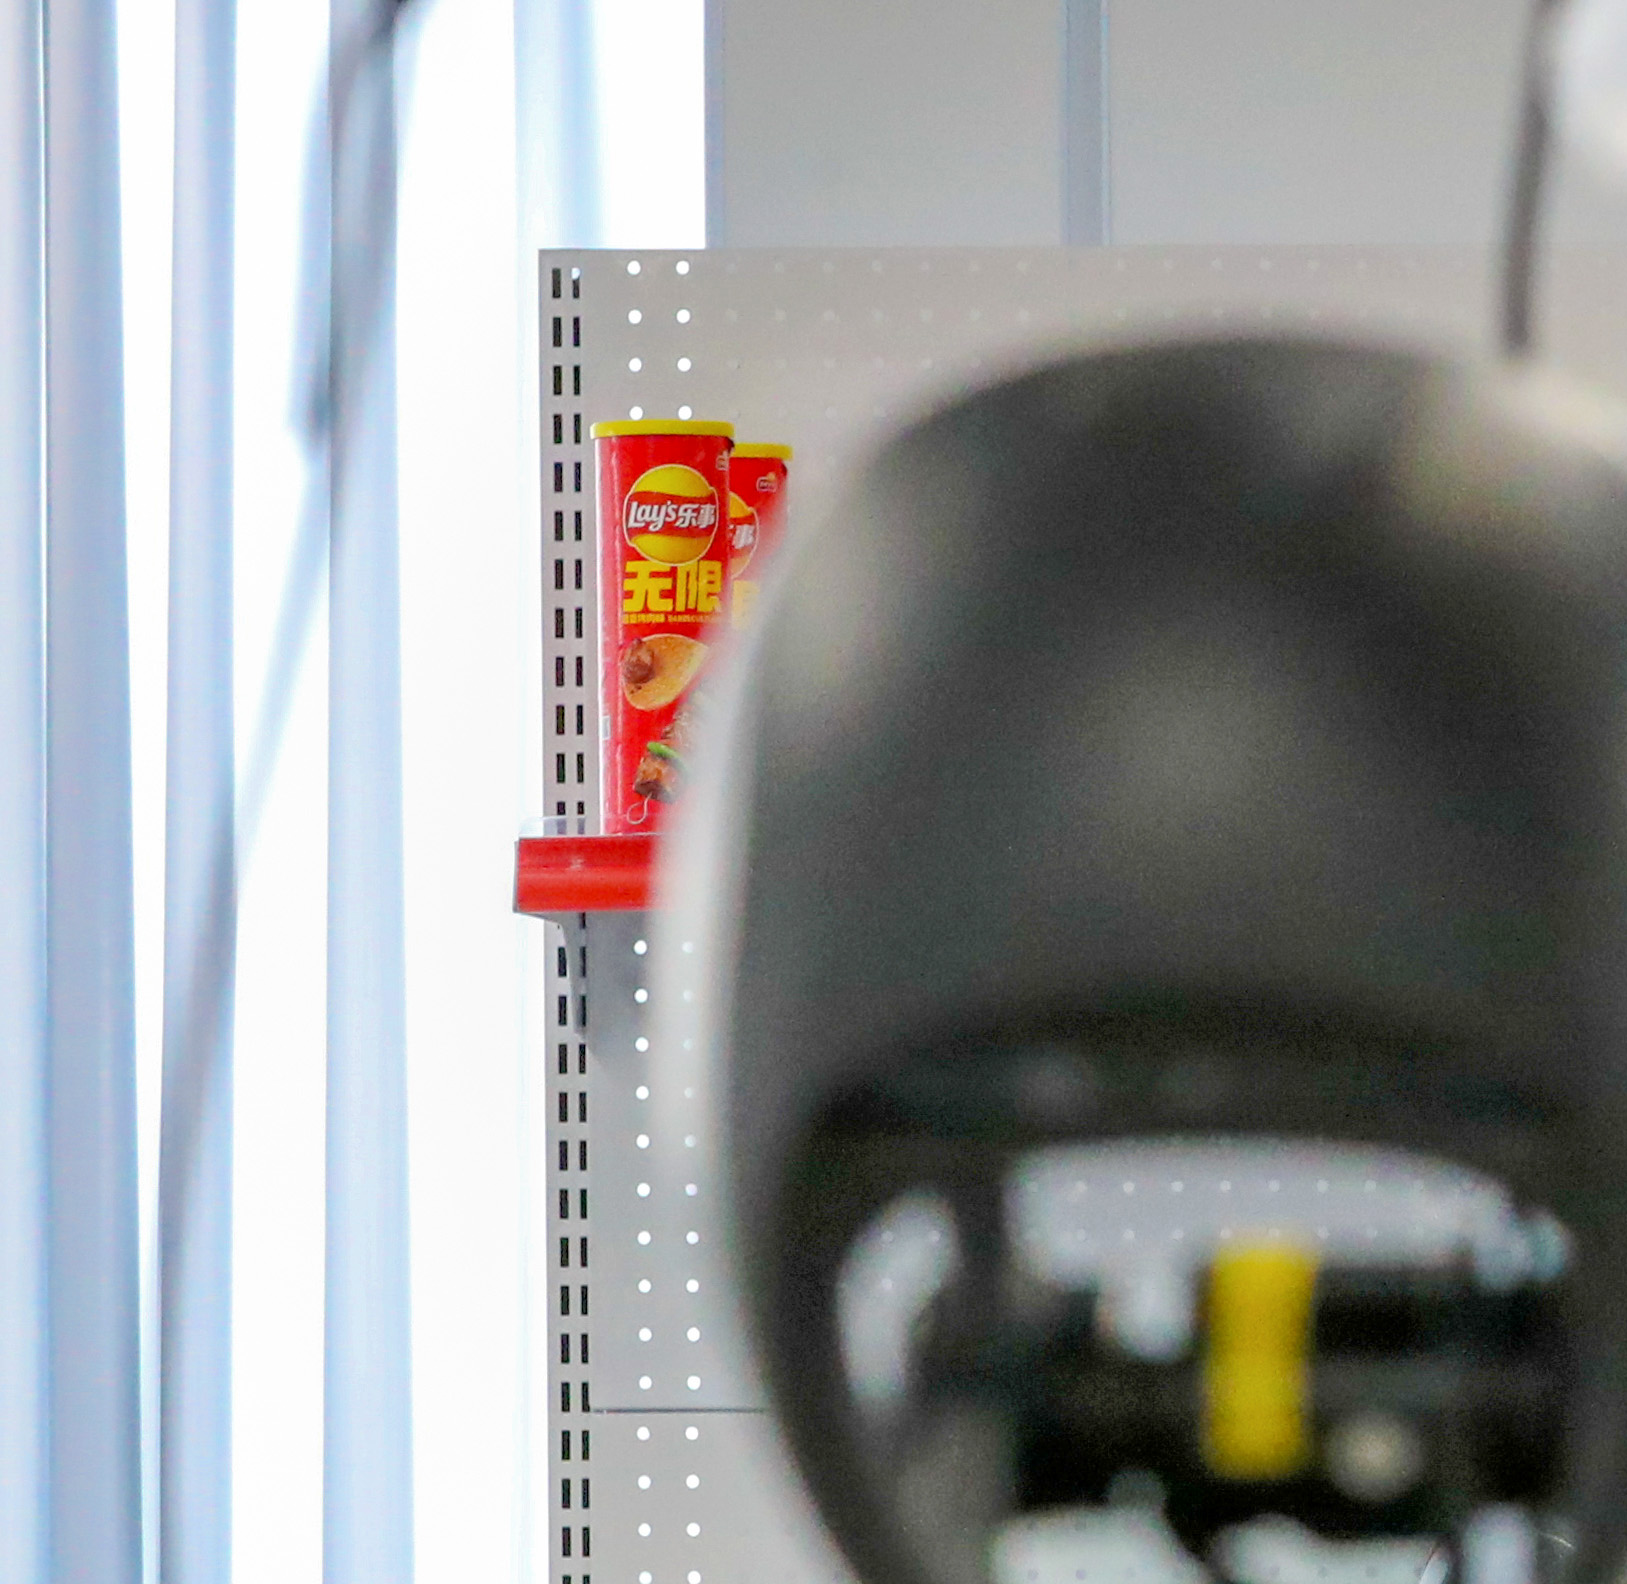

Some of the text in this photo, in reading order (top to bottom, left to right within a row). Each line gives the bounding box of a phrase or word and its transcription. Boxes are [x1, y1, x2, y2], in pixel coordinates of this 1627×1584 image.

[628, 501, 716, 531] Lay's 乐事
[623, 560, 723, 613] 无限
